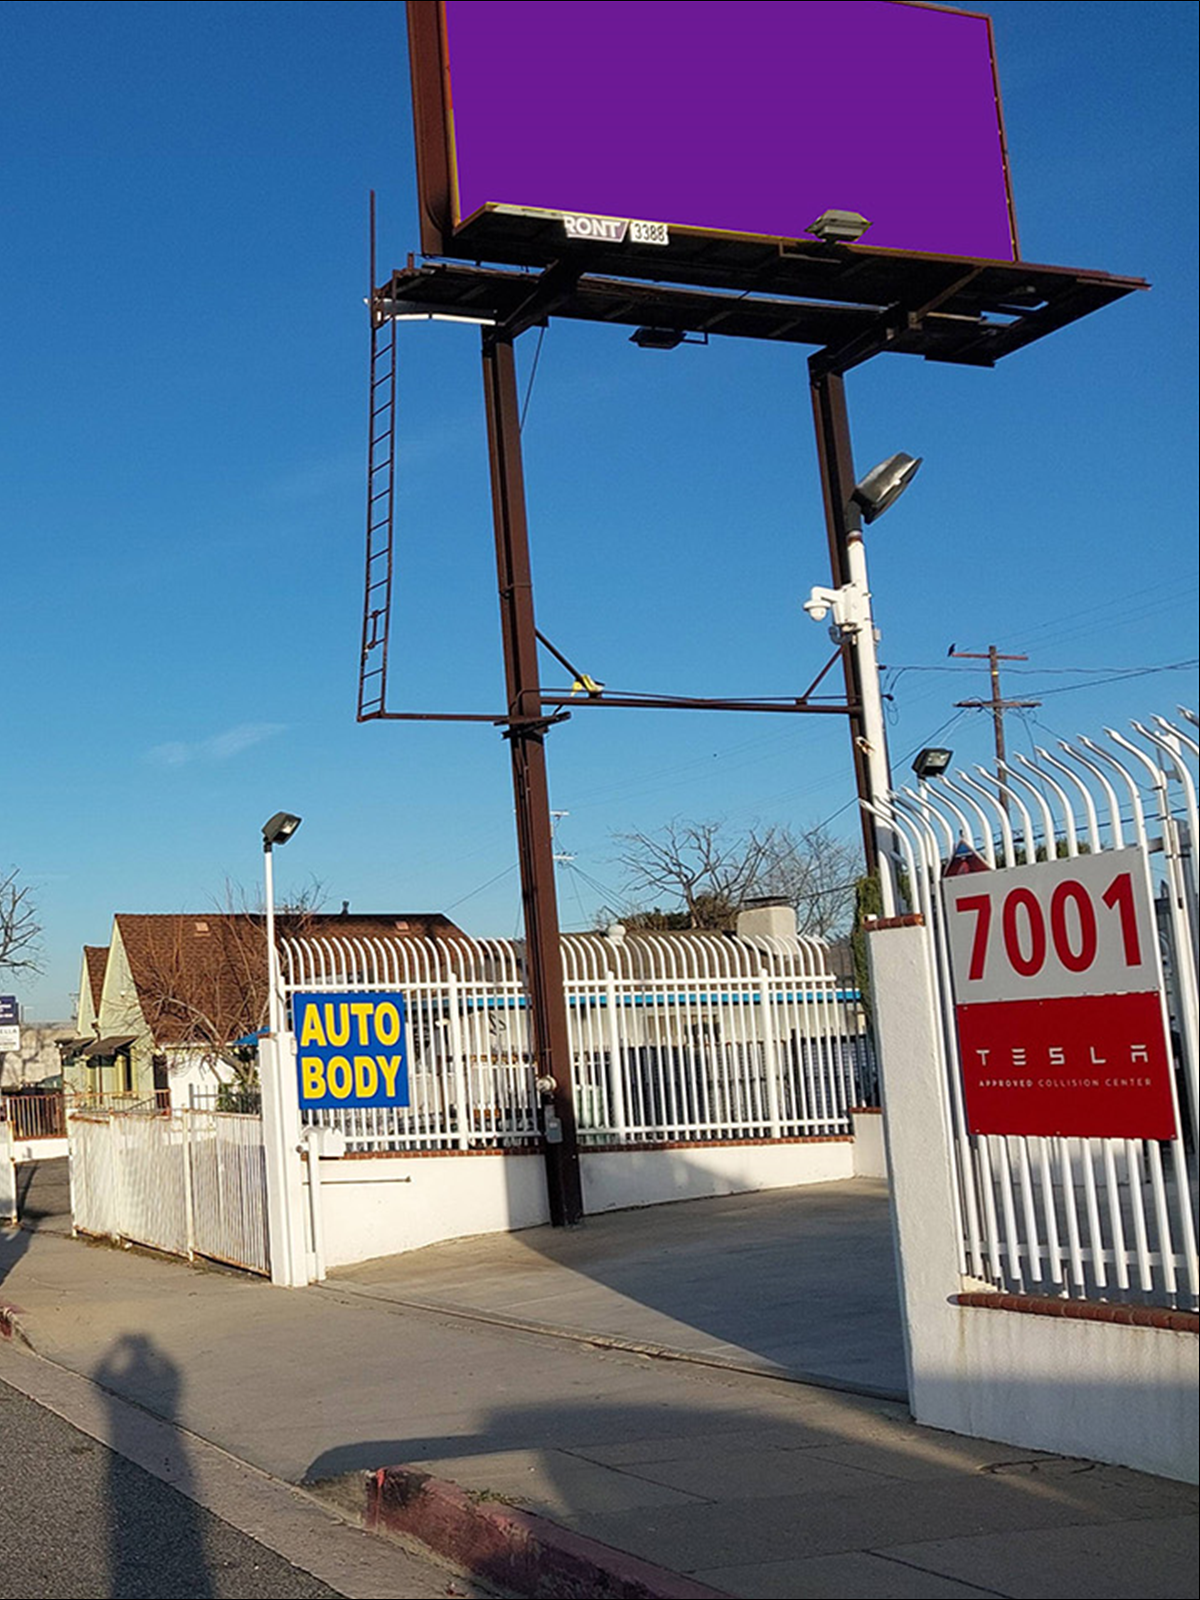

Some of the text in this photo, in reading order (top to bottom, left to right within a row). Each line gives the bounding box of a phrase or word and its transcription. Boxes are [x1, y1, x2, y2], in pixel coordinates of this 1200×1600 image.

[634, 222, 665, 242] 3388
[955, 873, 1142, 981] 7001
[301, 1002, 400, 1047] AUTO
[976, 1044, 1149, 1066] TESLA
[301, 1055, 402, 1099] BODY
[978, 1077, 1152, 1088] APPROVED COLLISION CENTER
